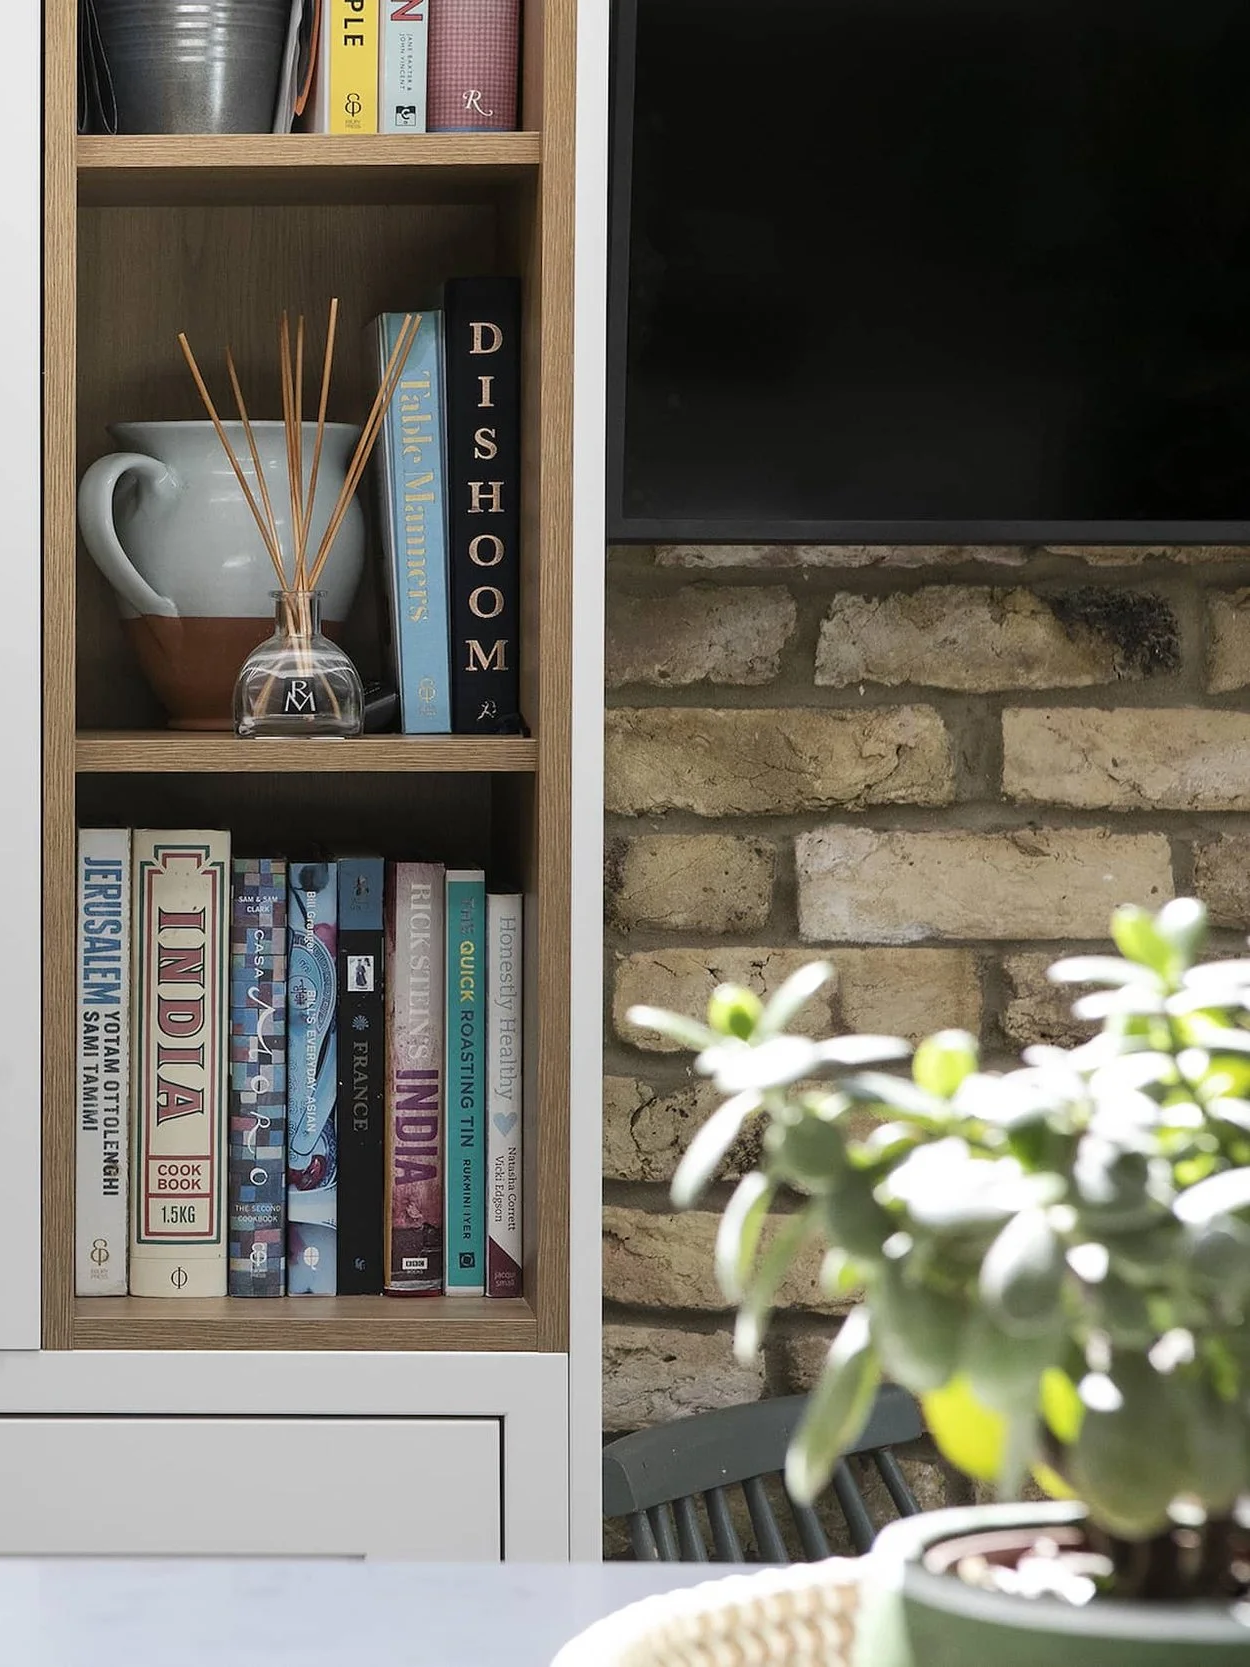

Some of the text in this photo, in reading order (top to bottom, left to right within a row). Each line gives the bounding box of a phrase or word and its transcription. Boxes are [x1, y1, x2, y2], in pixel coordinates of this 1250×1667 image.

[405, 33, 414, 51] JANE
[405, 54, 414, 83] BAXTER
[401, 370, 435, 623] Table Manners
[465, 322, 509, 672] DISHOOM
[238, 895, 278, 903] SAM & SAM
[247, 905, 270, 913] CLARK
[306, 891, 316, 908] Bill
[410, 883, 432, 948] RICK
[83, 856, 122, 1005] JERUSALEM
[254, 929, 265, 979] CASA
[460, 940, 476, 1002] QUICK
[156, 906, 206, 1128] INDIA
[494, 917, 518, 1100] Honestly Healthy
[82, 1011, 100, 1131] SAMI TAMIMI
[306, 1031, 317, 1092] EVERYDAY
[353, 1042, 370, 1132] FRANCE
[460, 1010, 475, 1109] ROASTING
[102, 1011, 120, 1196] YOTAM OTTOLENGHI
[306, 1096, 317, 1132] ASIAN
[395, 1069, 440, 1186] INDIA
[460, 1117, 475, 1148] TIN
[157, 1164, 202, 1177] COOK
[157, 1178, 202, 1191] BOOK
[462, 1159, 471, 1239] RUKMINI IYER
[493, 1155, 505, 1222] Vicki Edgson
[507, 1147, 517, 1231] Natasha Corrett
[161, 1205, 196, 1224] 1.5KG
[236, 1204, 282, 1213] THE SECOND
[238, 1215, 278, 1223] COOKBOOK
